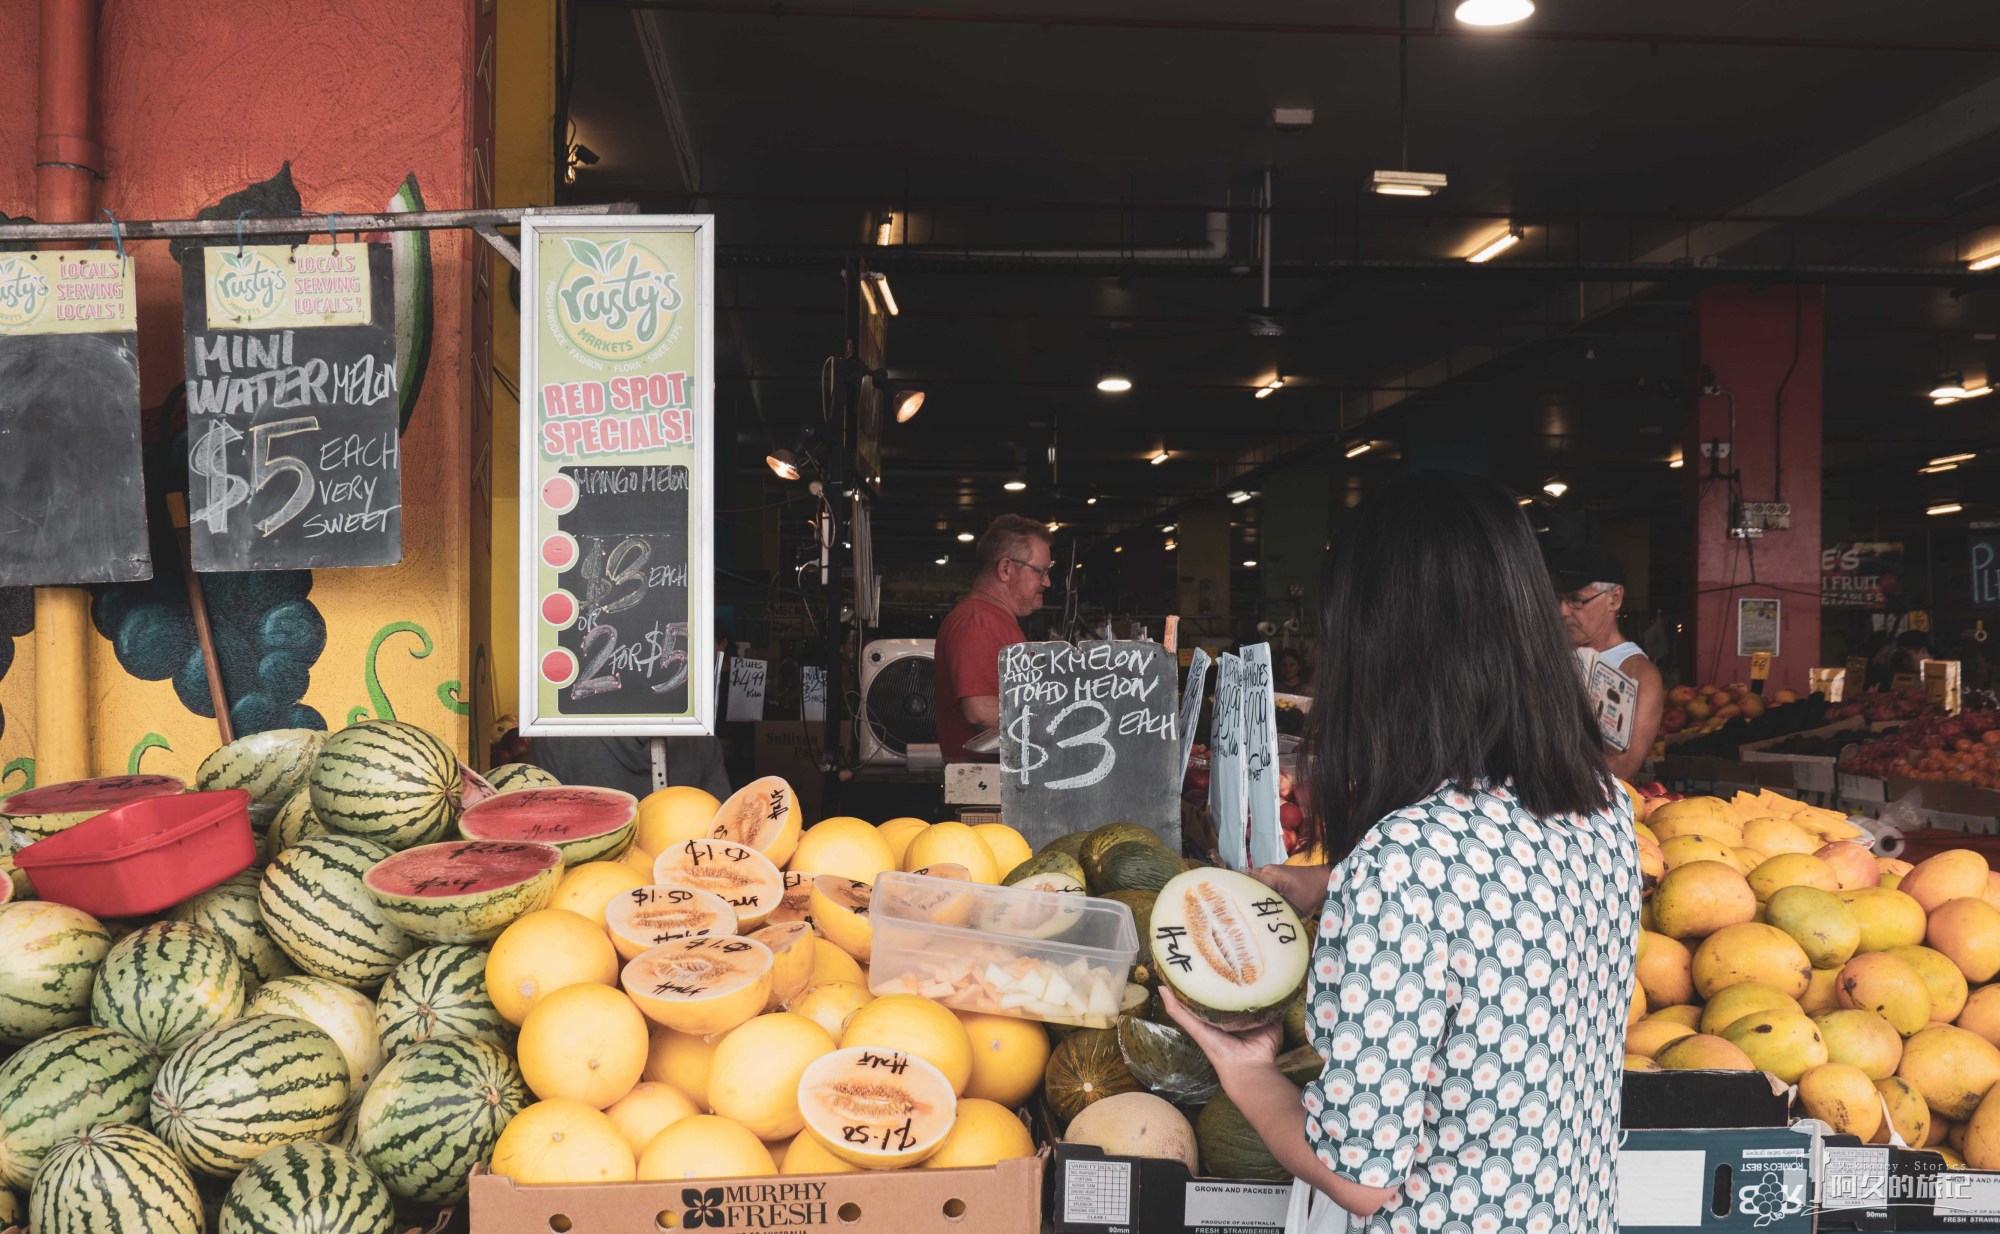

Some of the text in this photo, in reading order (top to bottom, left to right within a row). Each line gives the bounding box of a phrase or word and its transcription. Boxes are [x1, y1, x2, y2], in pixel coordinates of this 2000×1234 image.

[60, 262, 118, 279] LOCALS
[297, 255, 355, 273] LOCALS
[56, 282, 123, 300] SERVING
[218, 260, 286, 307] rusty's
[294, 277, 360, 294] SERVING
[560, 255, 682, 342] rusty's
[194, 330, 295, 376] MINI
[577, 327, 634, 353] MARKETS
[569, 348, 604, 370] FASHION
[614, 361, 641, 372] FLORA
[647, 341, 671, 362] SINCE
[544, 371, 688, 418] RED SPOT
[543, 408, 694, 455] SPECIALS!
[189, 415, 398, 538] $5 EACH
[573, 464, 689, 494] MANGO MELON
[319, 474, 378, 514] VERY
[302, 504, 402, 538] SWEET
[647, 561, 688, 588] EACH
[1831, 575, 1880, 591] FRUIT
[577, 607, 602, 632] OR
[570, 620, 689, 700] 2 FOR $5
[1003, 642, 1153, 676] ROCKMELON
[1003, 668, 1044, 684] AND
[1004, 671, 1159, 707] TOAD MELON
[1000, 699, 1117, 790] $3
[1118, 706, 1177, 741] EACH
[685, 839, 750, 866] $1.50
[631, 888, 693, 907] $1.50
[1251, 896, 1297, 945] $1.50
[842, 1116, 917, 1152] $1.50
[1740, 1162, 1804, 1172] ROMEO'S BEST
[1974, 1176, 1992, 1184] AND
[726, 1182, 827, 1204] MURPHY
[1194, 1185, 1223, 1193] GROWN
[1242, 1187, 1273, 1195] PACKED
[1274, 1188, 1288, 1196] BY:
[726, 1202, 829, 1229] FRESH
[1866, 1210, 1888, 1219] 90mm
